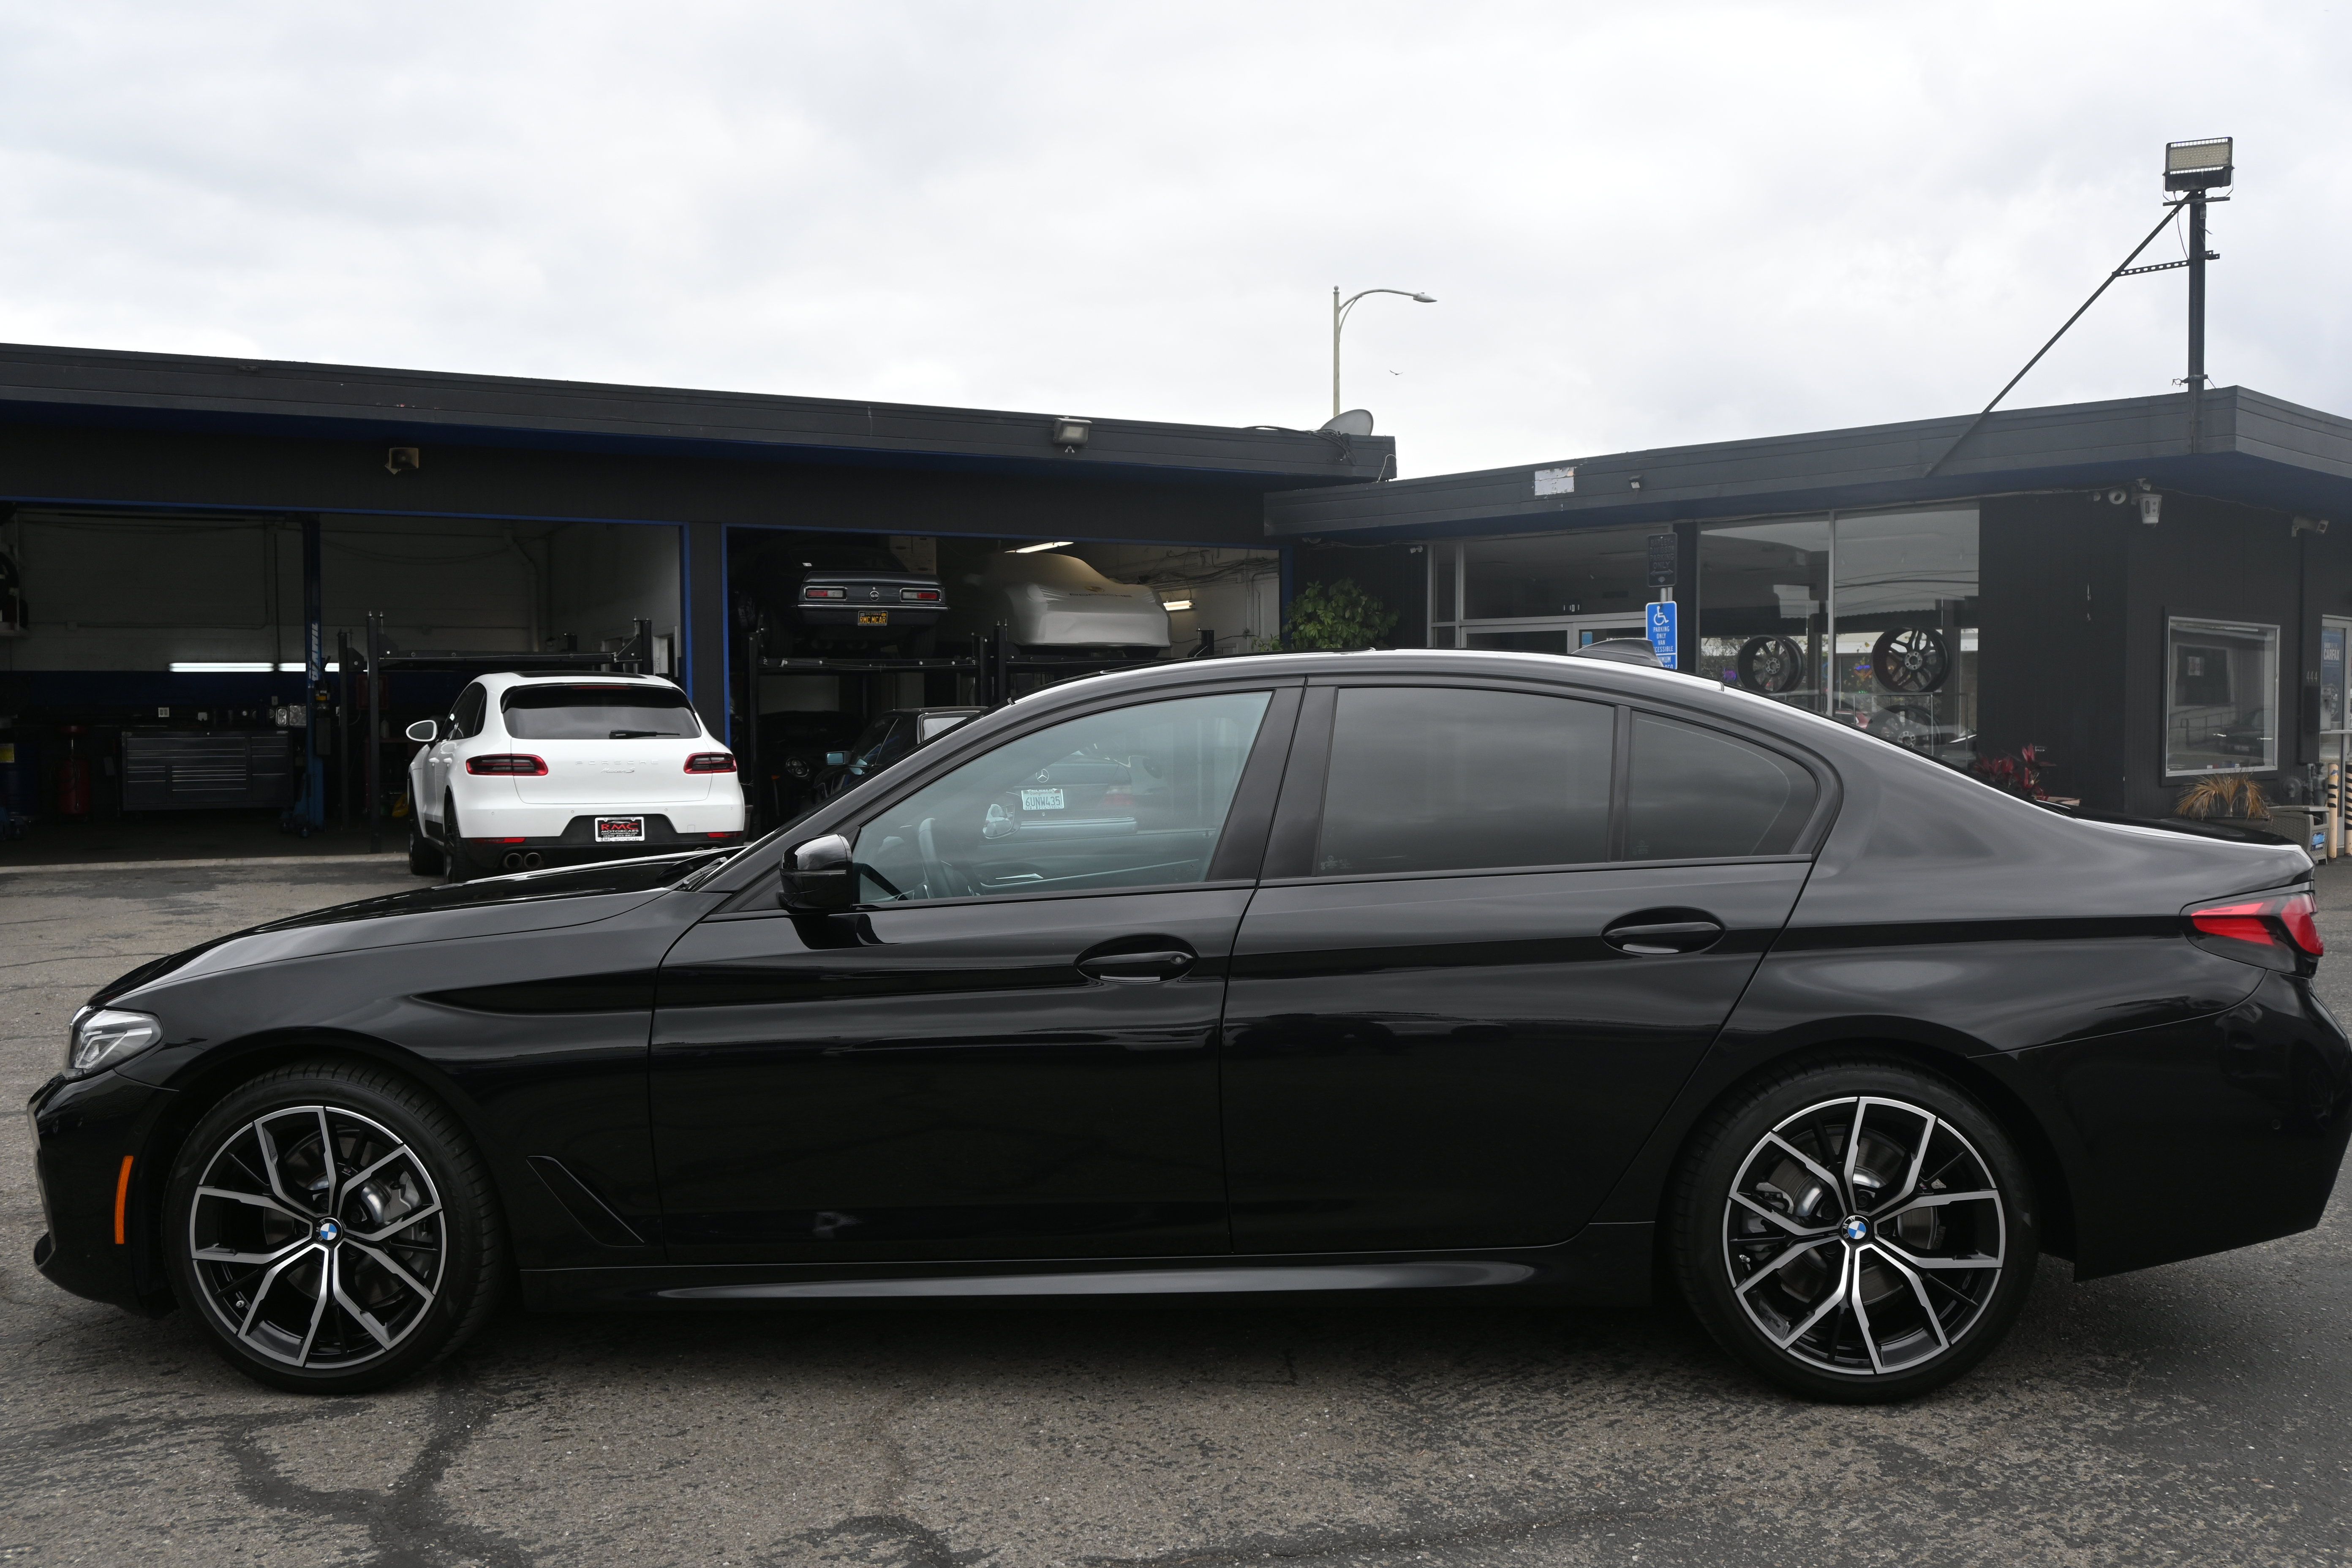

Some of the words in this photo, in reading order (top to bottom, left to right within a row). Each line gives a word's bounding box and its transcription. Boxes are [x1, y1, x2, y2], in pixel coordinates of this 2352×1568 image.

[1650, 545, 1674, 554] DAVIDSON
[1650, 553, 1674, 561] PARKING
[2324, 649, 2340, 661] CARFAX
[2306, 671, 2318, 683] 444
[1026, 796, 1060, 806] 6UNW435
[601, 822, 639, 830] RMC
[1843, 1216, 1855, 1239] BMW
